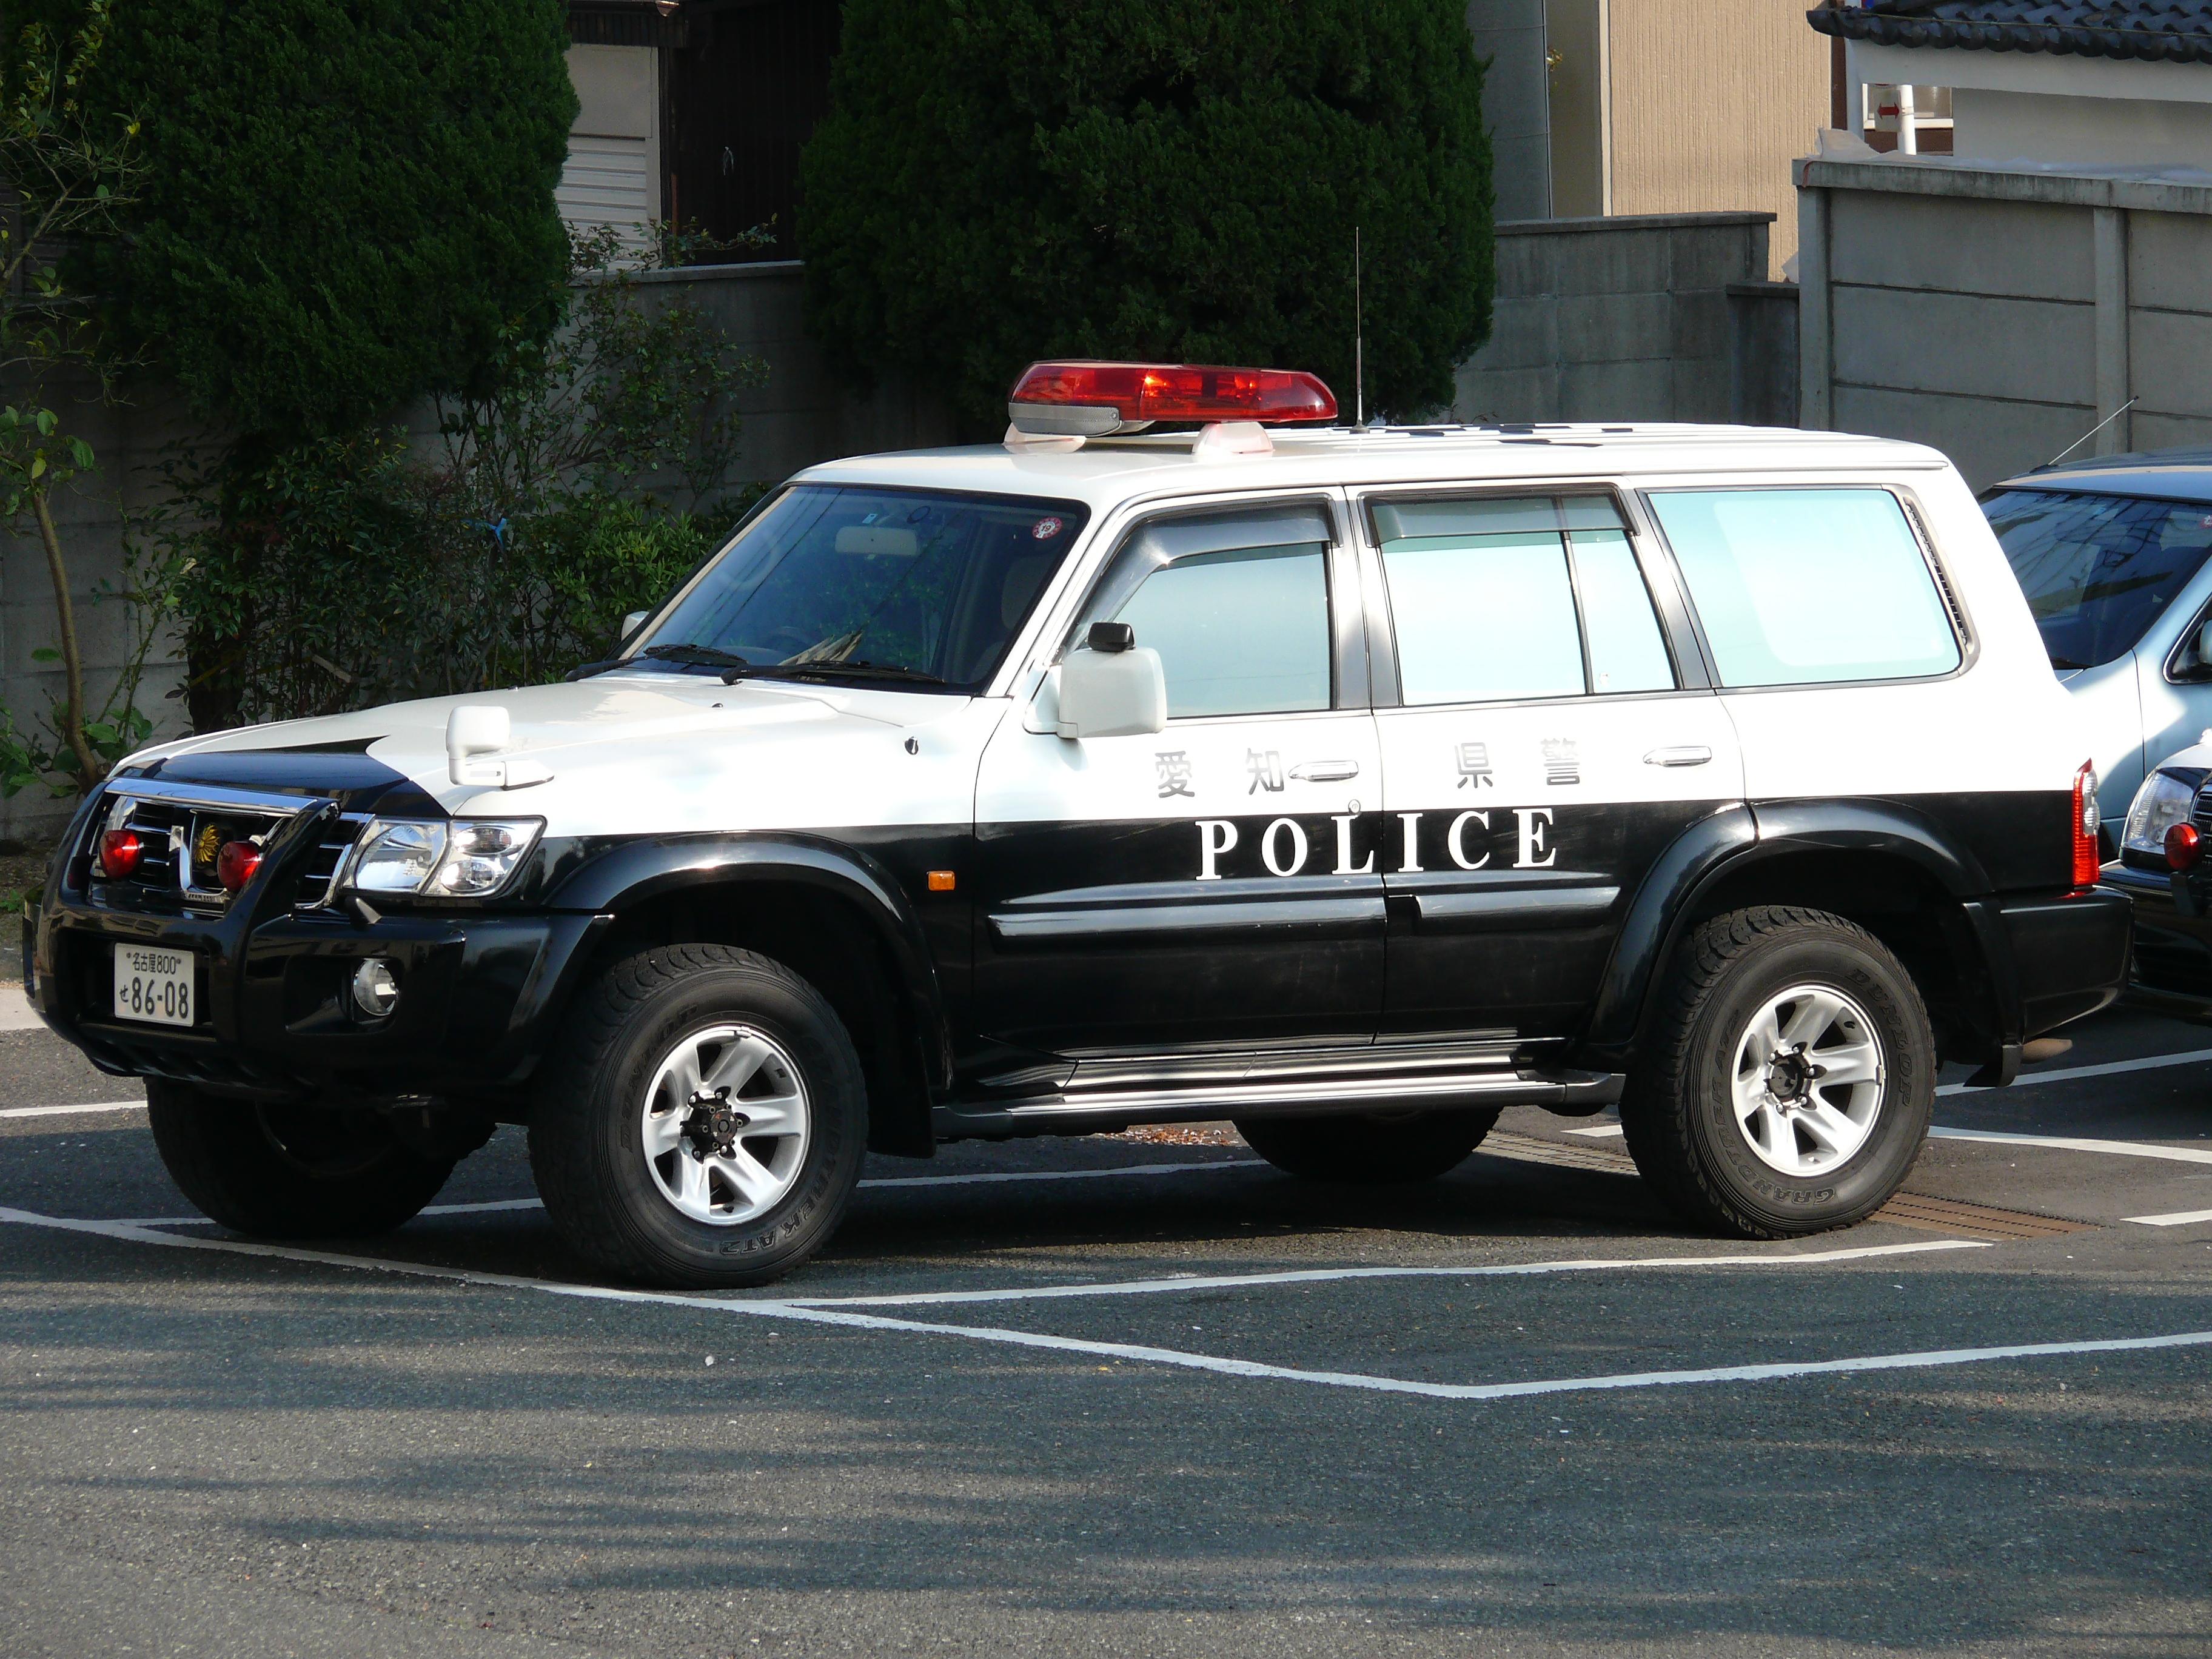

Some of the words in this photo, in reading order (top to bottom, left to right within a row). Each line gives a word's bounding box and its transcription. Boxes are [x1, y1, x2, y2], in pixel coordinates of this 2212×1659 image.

[1195, 808, 1557, 880] POLICE
[132, 976, 189, 1019] 86-08
[1845, 969, 1912, 1107] DUNLOP
[1712, 1077, 1835, 1206] GRANDTREK
[719, 1230, 777, 1256] AT2
